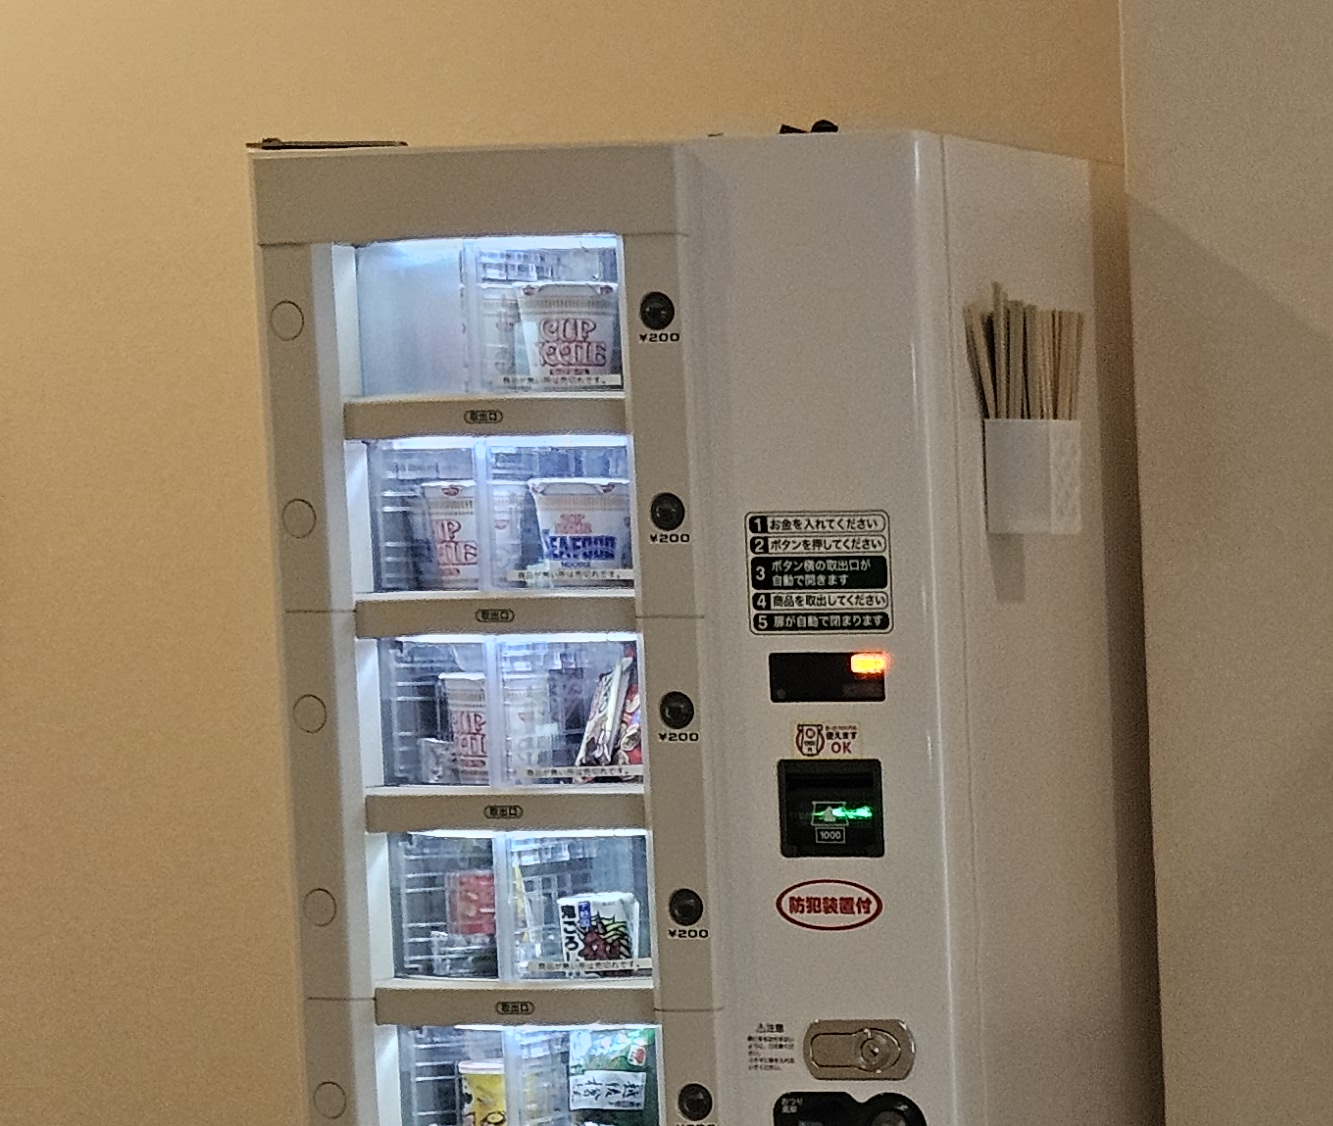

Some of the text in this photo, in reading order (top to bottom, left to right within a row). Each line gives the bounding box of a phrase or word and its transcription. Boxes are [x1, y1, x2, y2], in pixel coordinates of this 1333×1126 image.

[639, 332, 680, 342] ¥200
[754, 518, 878, 532] 1 お金を入れてください
[650, 533, 690, 543] ¥200
[754, 538, 883, 553] 2 ボタンを押してください
[756, 559, 871, 580] 3 ボタン横の取出口が
[772, 574, 849, 586] 自動で開きます
[756, 595, 885, 608] 4 商品を取出してください
[758, 614, 883, 629] 5 扉が自動で閉まります
[658, 732, 699, 742] ¥200
[831, 742, 852, 753] OK
[788, 896, 873, 915] 防犯装置付
[668, 929, 709, 939] ¥200
